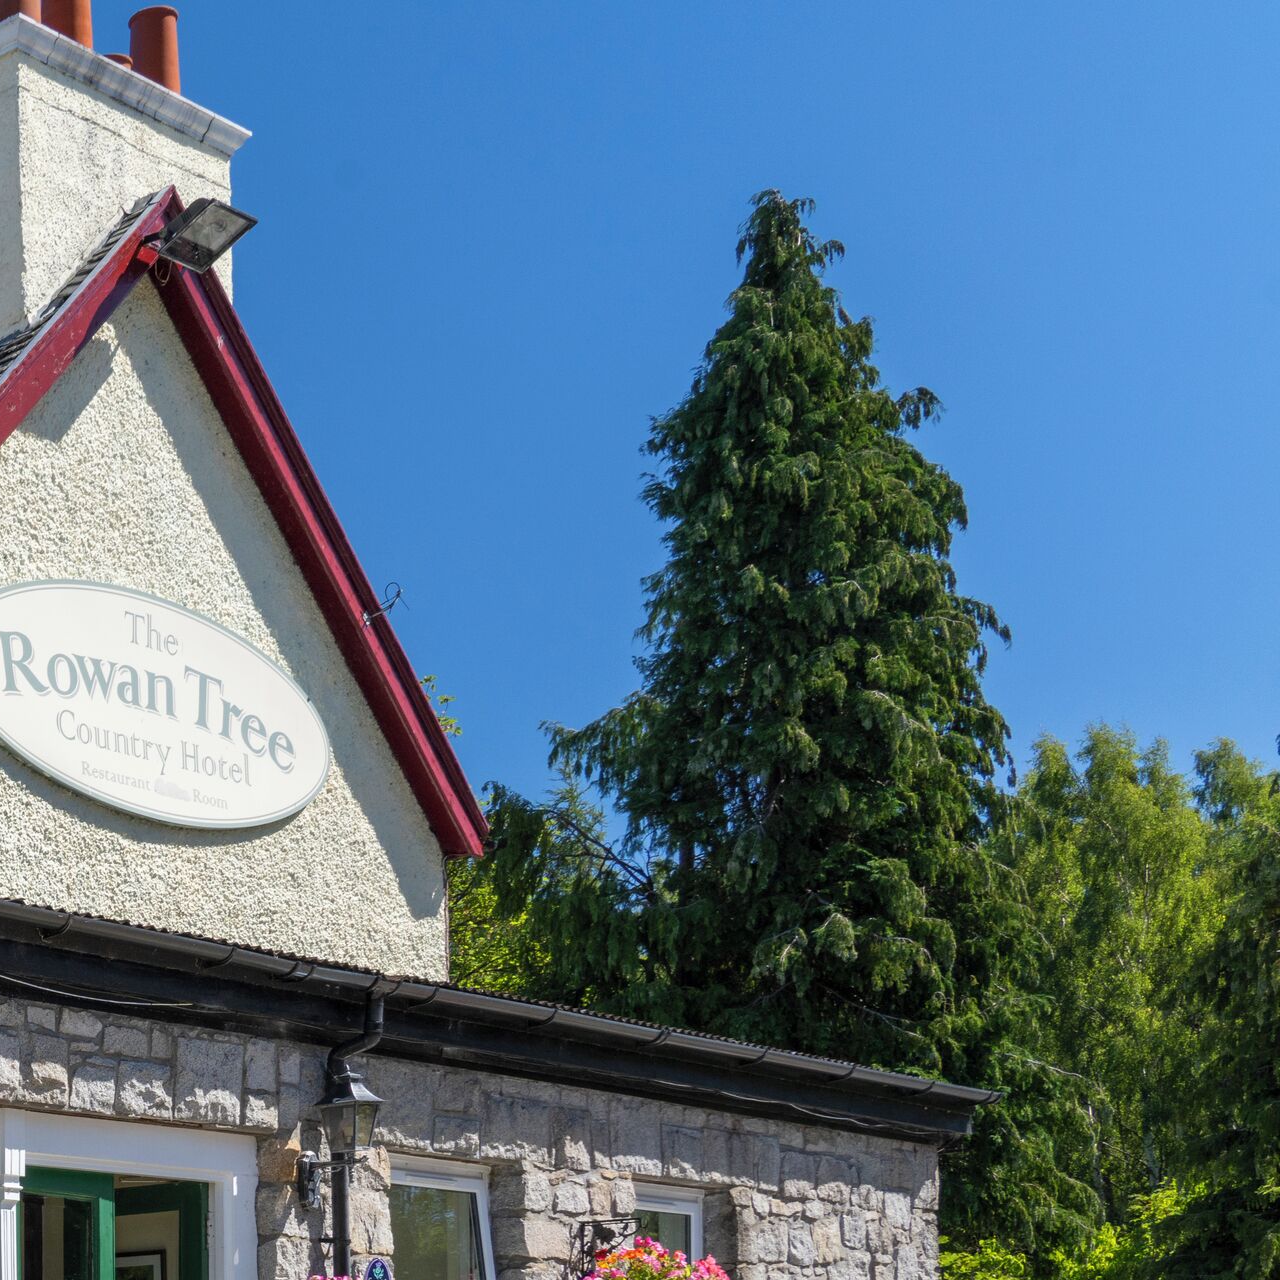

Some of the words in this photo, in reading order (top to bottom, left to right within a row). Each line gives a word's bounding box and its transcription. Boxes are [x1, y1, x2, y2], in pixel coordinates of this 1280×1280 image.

[124, 611, 178, 656] The
[56, 709, 171, 775] Country
[181, 740, 252, 787] Hotel
[184, 665, 296, 774] Tree
[81, 760, 151, 792] Restaurant
[192, 788, 228, 810] Room
